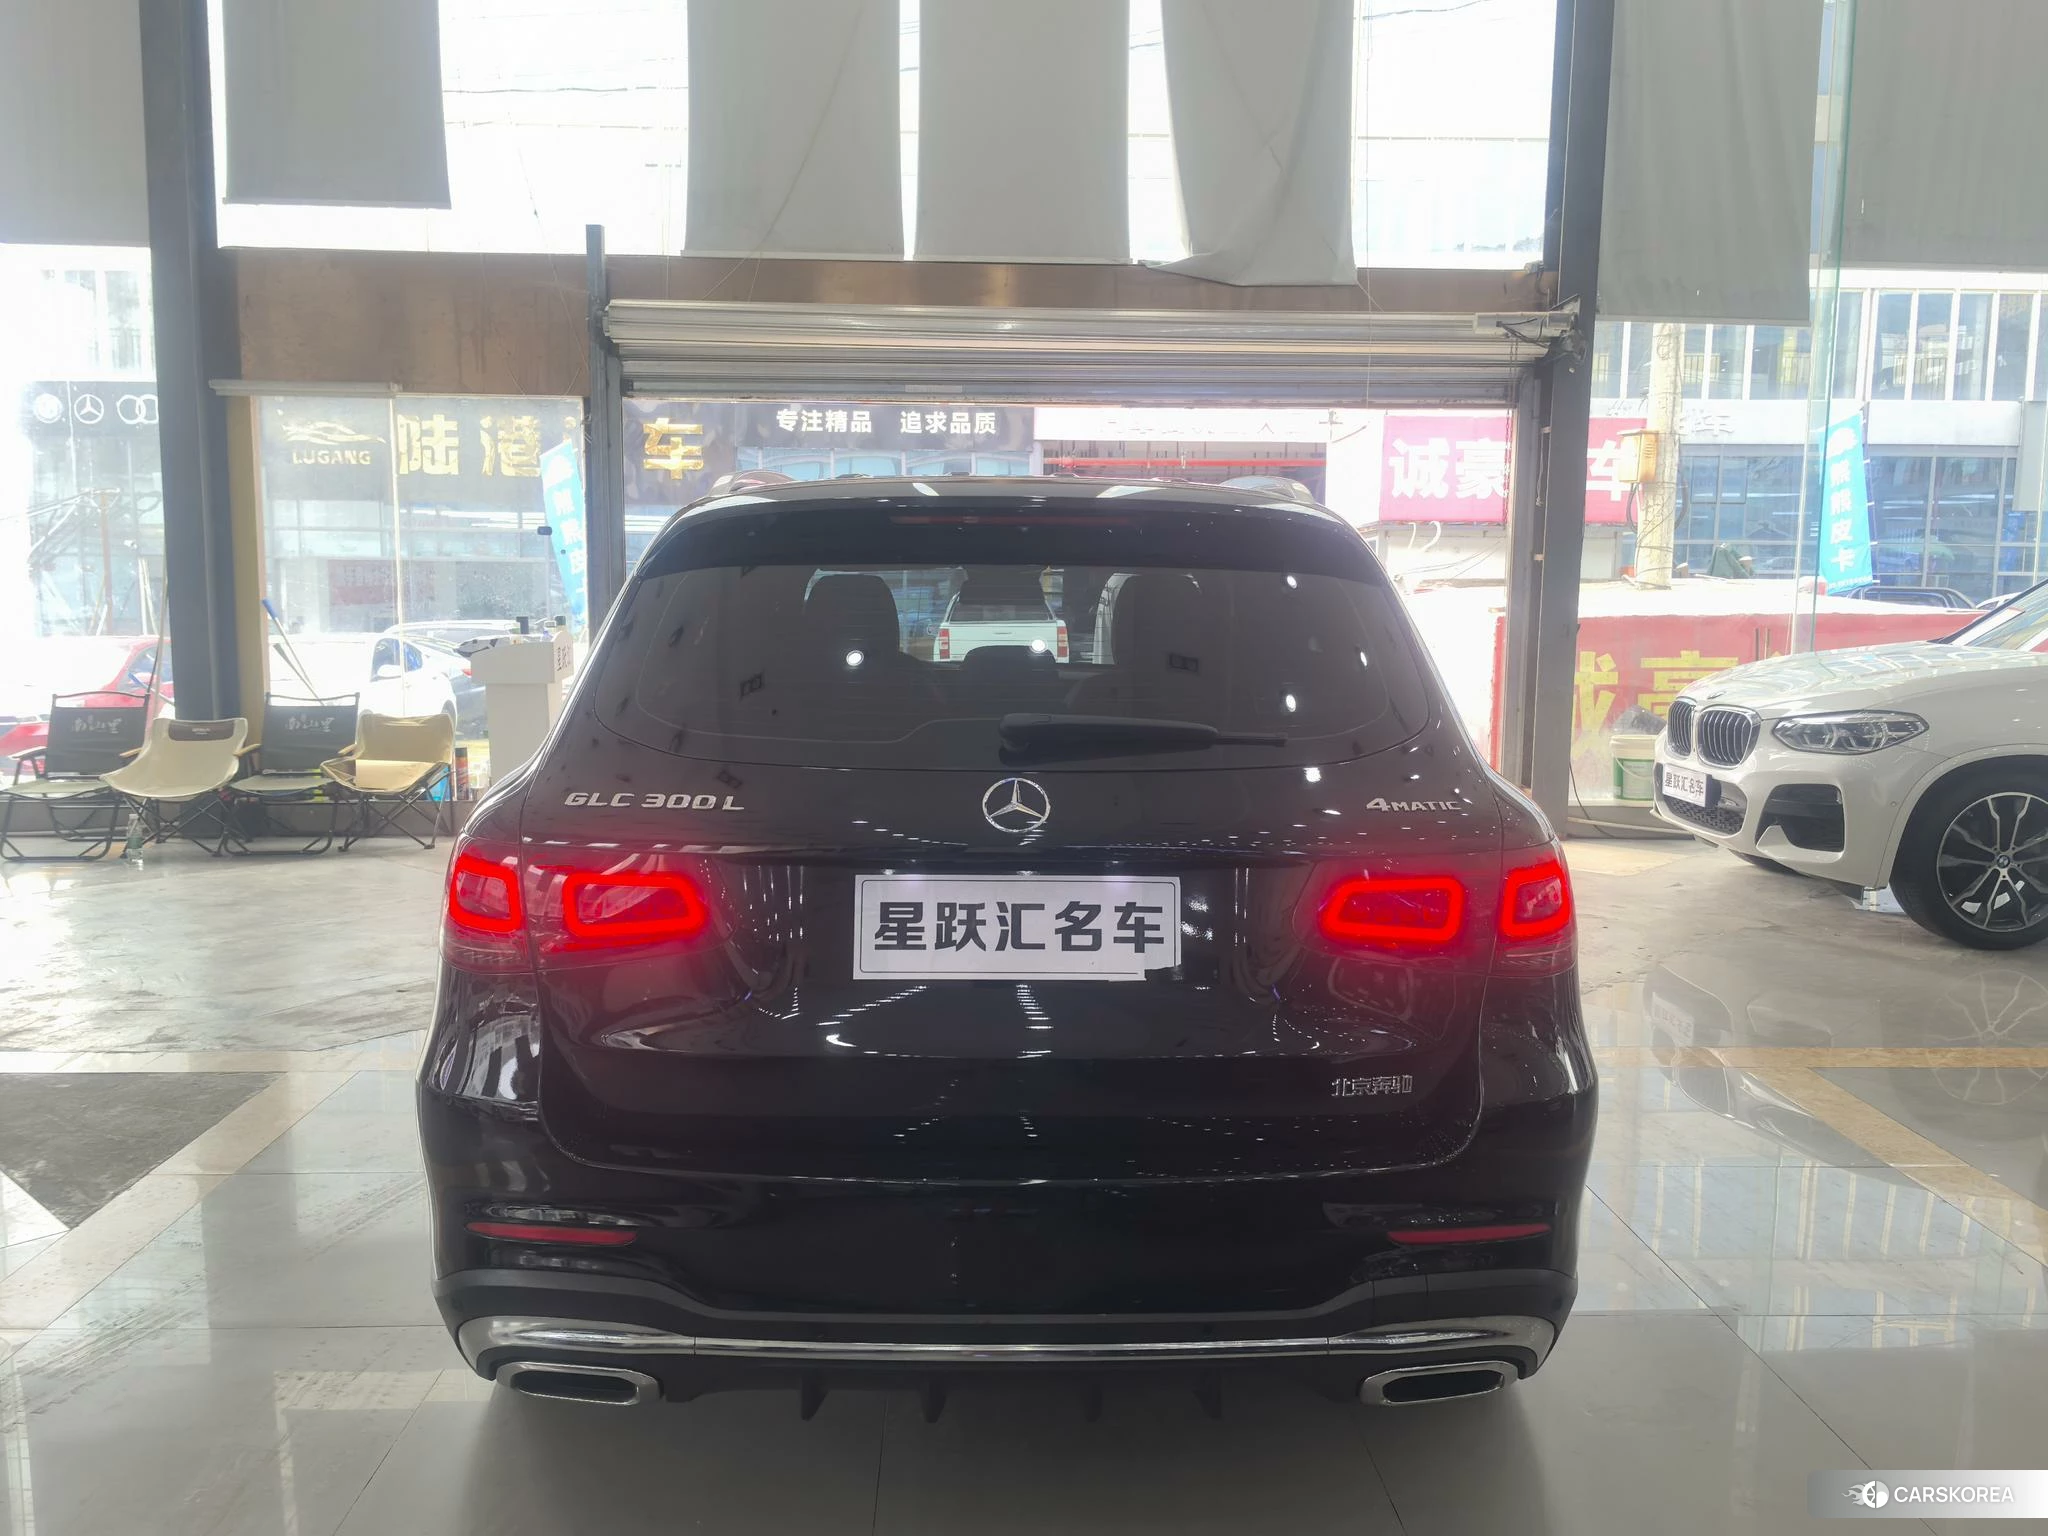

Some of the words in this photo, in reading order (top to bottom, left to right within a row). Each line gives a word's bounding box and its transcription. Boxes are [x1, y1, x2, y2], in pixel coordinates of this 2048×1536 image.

[776, 409, 872, 433] 专注精品
[900, 411, 997, 435] 追求品质
[293, 450, 371, 465] LUGANG
[397, 414, 541, 478] 陆港
[643, 418, 704, 480] 车
[1388, 437, 1510, 499] 诚豪
[1665, 772, 1704, 797] 星跃汇名车
[564, 792, 636, 808] GLC
[1366, 797, 1461, 812] 4MATIC
[873, 900, 1164, 952] 星跃汇名车
[1331, 1074, 1413, 1097] 北京奔驰
